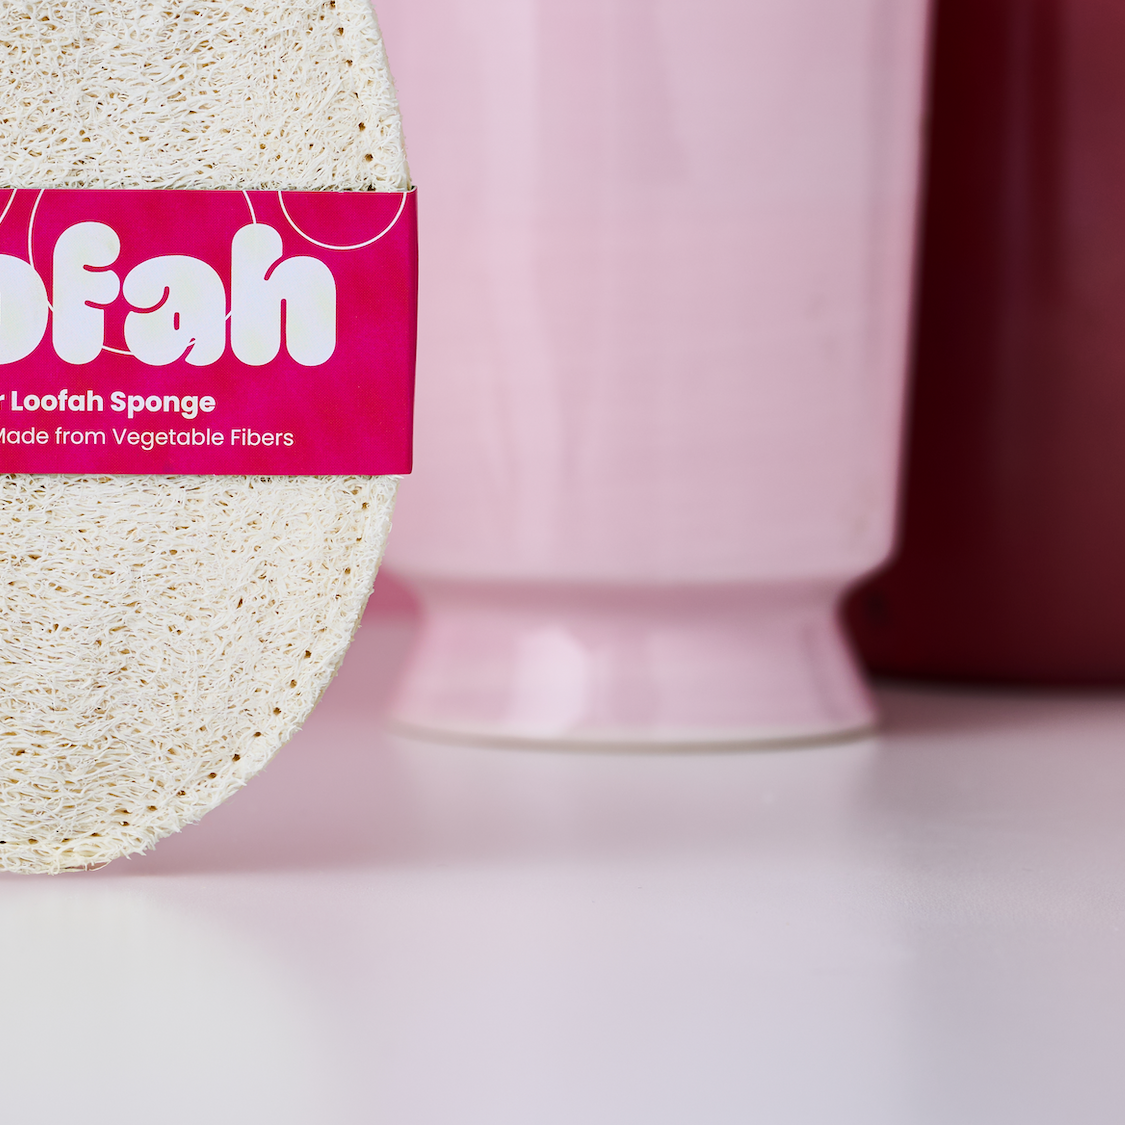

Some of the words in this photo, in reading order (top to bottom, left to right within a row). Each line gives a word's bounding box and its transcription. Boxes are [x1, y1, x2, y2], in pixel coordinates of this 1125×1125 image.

[11, 388, 104, 412] Loofah
[111, 389, 216, 420] Sponge
[55, 426, 106, 446] from
[112, 426, 225, 451] Vegetable
[230, 427, 294, 448] Fibers
